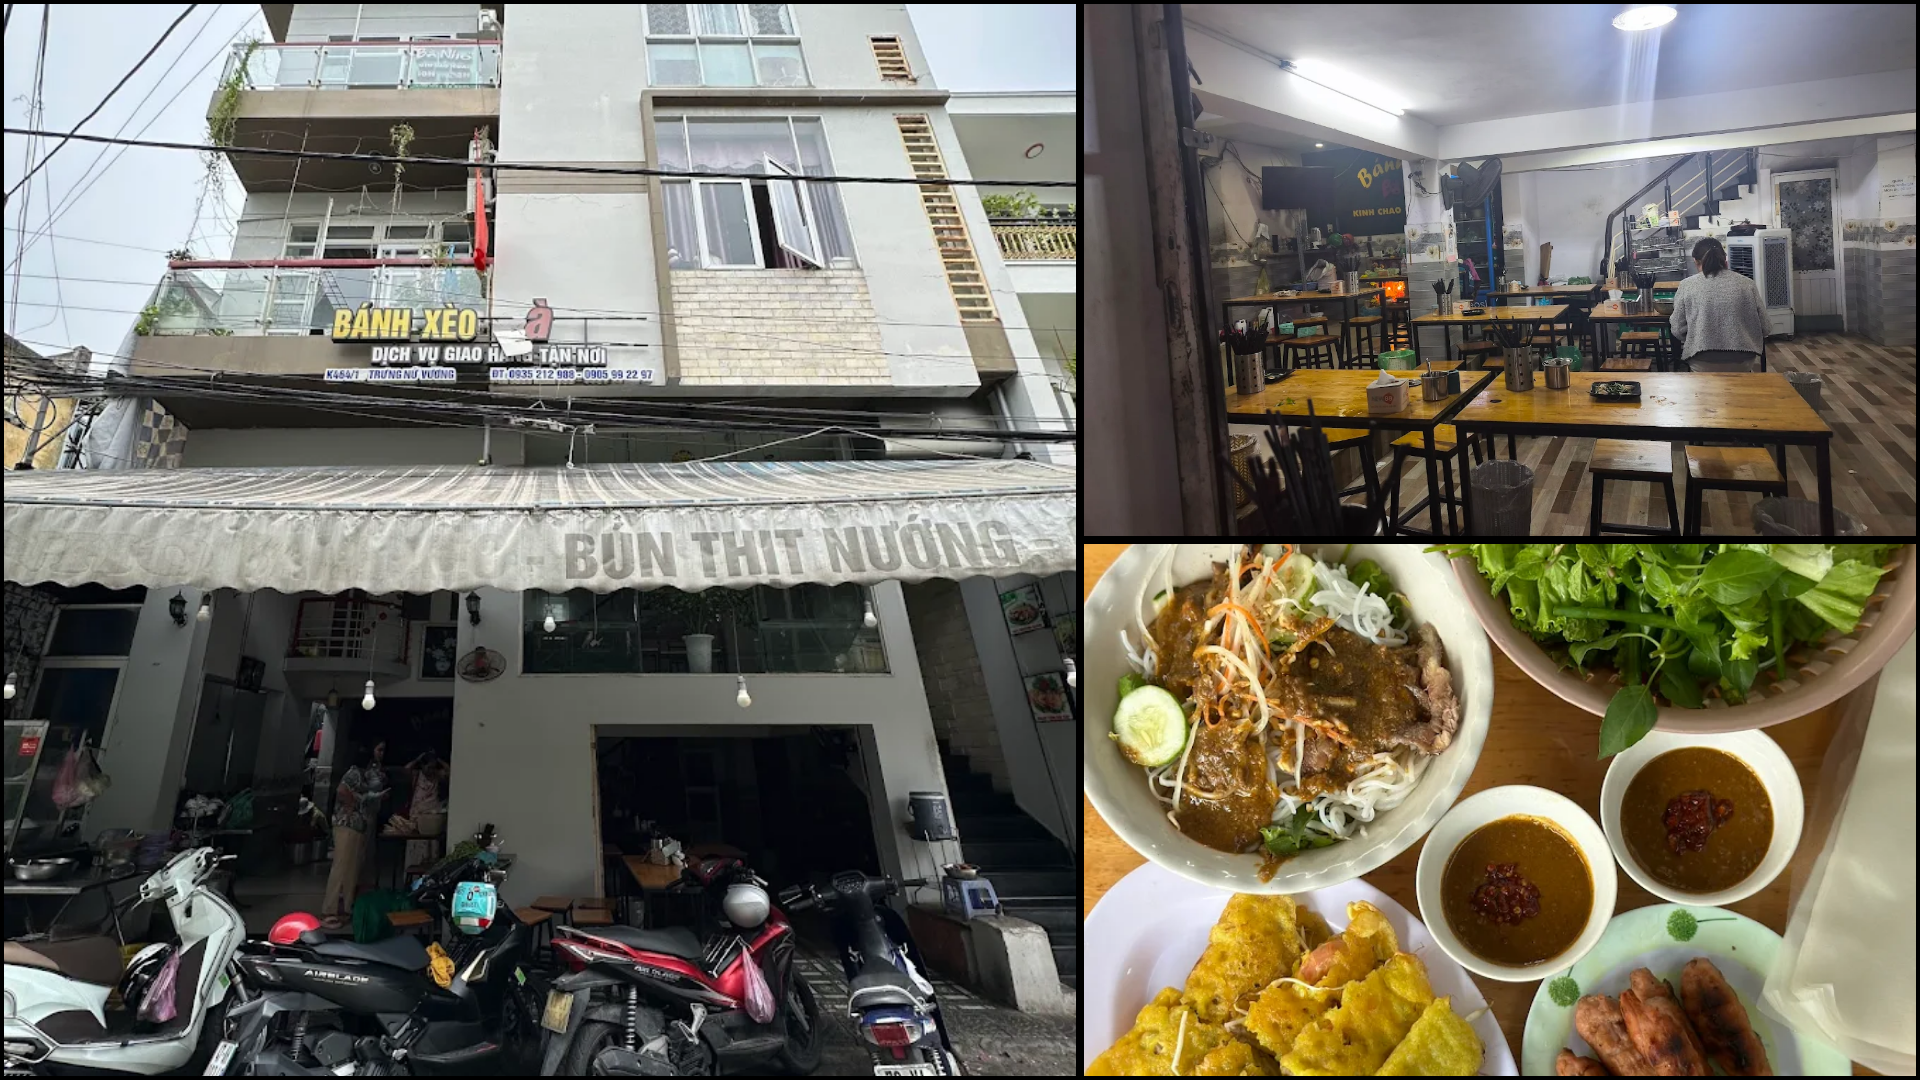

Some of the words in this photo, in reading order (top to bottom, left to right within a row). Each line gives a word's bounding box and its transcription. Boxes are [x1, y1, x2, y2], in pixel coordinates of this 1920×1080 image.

[1353, 208, 1375, 217] KINH
[332, 302, 411, 340] BÁNH
[420, 302, 478, 341] XÈO
[371, 346, 411, 366] DỊCH
[418, 346, 440, 366] VỤ
[444, 346, 483, 362] GIAO
[539, 345, 571, 366] TẬN
[577, 345, 607, 364] NƠI
[369, 368, 402, 380] TRƯNG
[421, 367, 455, 380] VƯƠNG
[508, 369, 533, 380] 0935
[535, 369, 555, 380] 212
[584, 369, 609, 380] 0905
[610, 369, 624, 380] 99
[626, 369, 639, 380] 22
[640, 369, 653, 380] 97
[564, 519, 677, 580] BÚN
[690, 529, 804, 586] THỊT
[822, 513, 1021, 573] NƯỚNG
